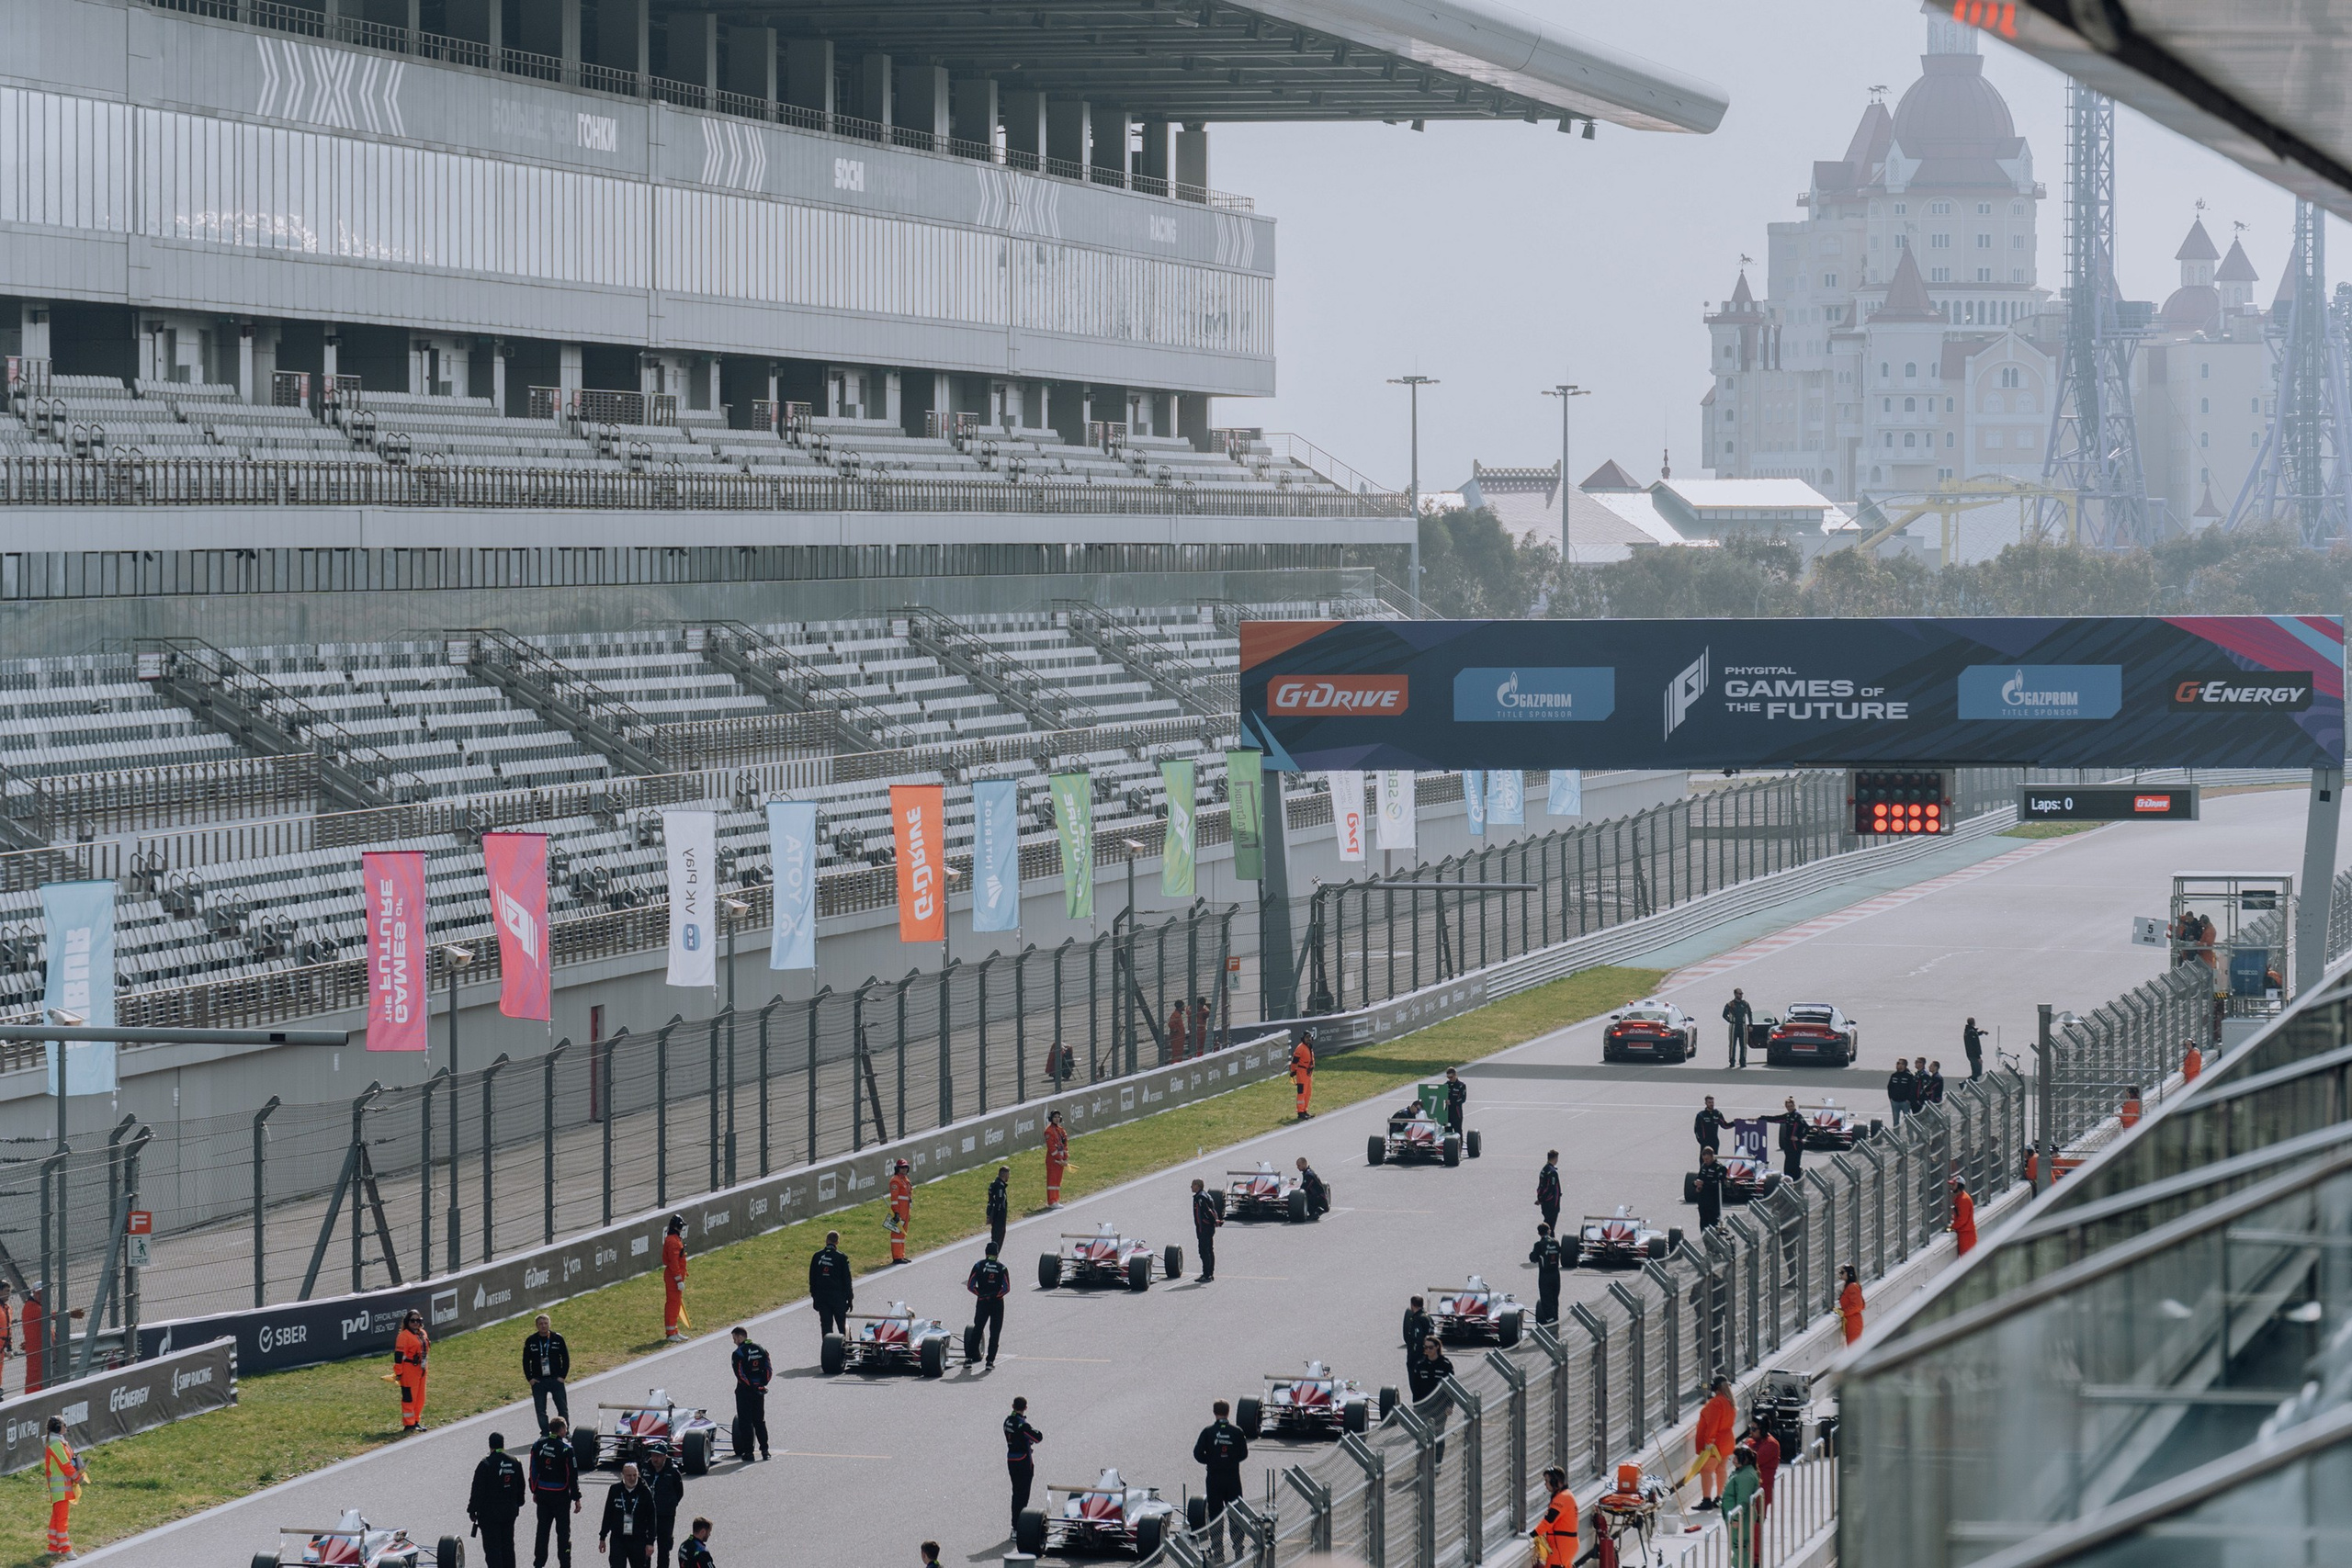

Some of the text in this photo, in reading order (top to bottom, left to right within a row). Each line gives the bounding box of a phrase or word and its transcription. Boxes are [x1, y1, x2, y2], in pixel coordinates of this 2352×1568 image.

[578, 112, 616, 152] ГОНКИ
[834, 157, 865, 192] SOCHI
[1150, 214, 1176, 244] RACING
[1724, 667, 1797, 675] PHYGITAL
[1724, 680, 1885, 698] GAMES OF
[1520, 693, 1572, 708] GAZPROM
[2024, 691, 2078, 705] GAZPROM
[1497, 710, 1572, 718] TITLE SPONSOR
[1724, 702, 1909, 719] THE FUTURE
[2031, 797, 2074, 812] Laps: 0
[2147, 924, 2154, 934] 5
[1229, 959, 1238, 970] F
[1429, 1095, 1437, 1114] 7
[1742, 1131, 1759, 1151] 10
[755, 1198, 768, 1215] SBER
[131, 1215, 148, 1231] F
[569, 1258, 581, 1274] YOTA
[486, 1289, 511, 1306] INTERROS
[374, 1311, 391, 1323] OFFICIAL
[276, 1325, 307, 1347] SBER
[178, 1367, 212, 1391] SMP RACING
[17, 1420, 40, 1439] VK Play
